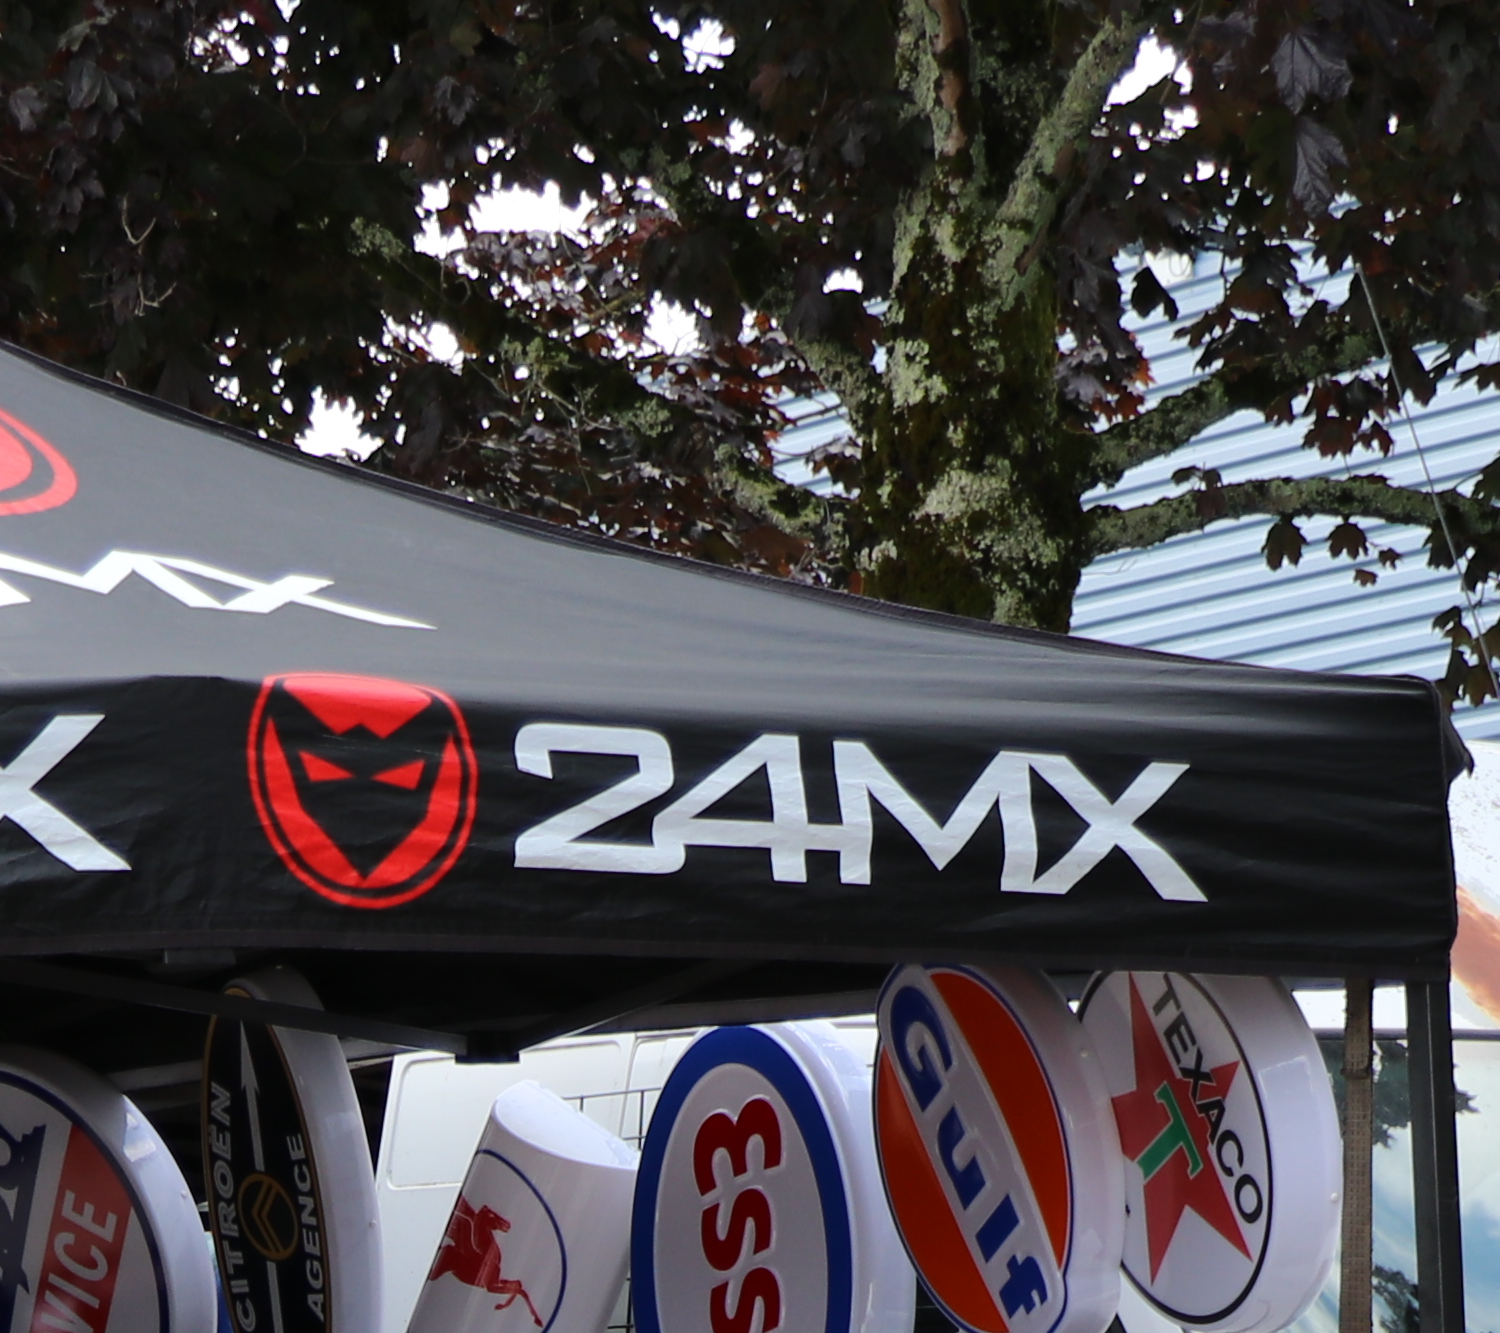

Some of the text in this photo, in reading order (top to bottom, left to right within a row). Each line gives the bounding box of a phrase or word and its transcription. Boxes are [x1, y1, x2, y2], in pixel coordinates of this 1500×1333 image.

[514, 723, 1209, 902] 24MX
[209, 1081, 256, 1332] CITROËN
[891, 985, 1048, 1317] Gulf
[1152, 972, 1263, 1224] TEXACO
[287, 1134, 324, 1322] AGENCE
